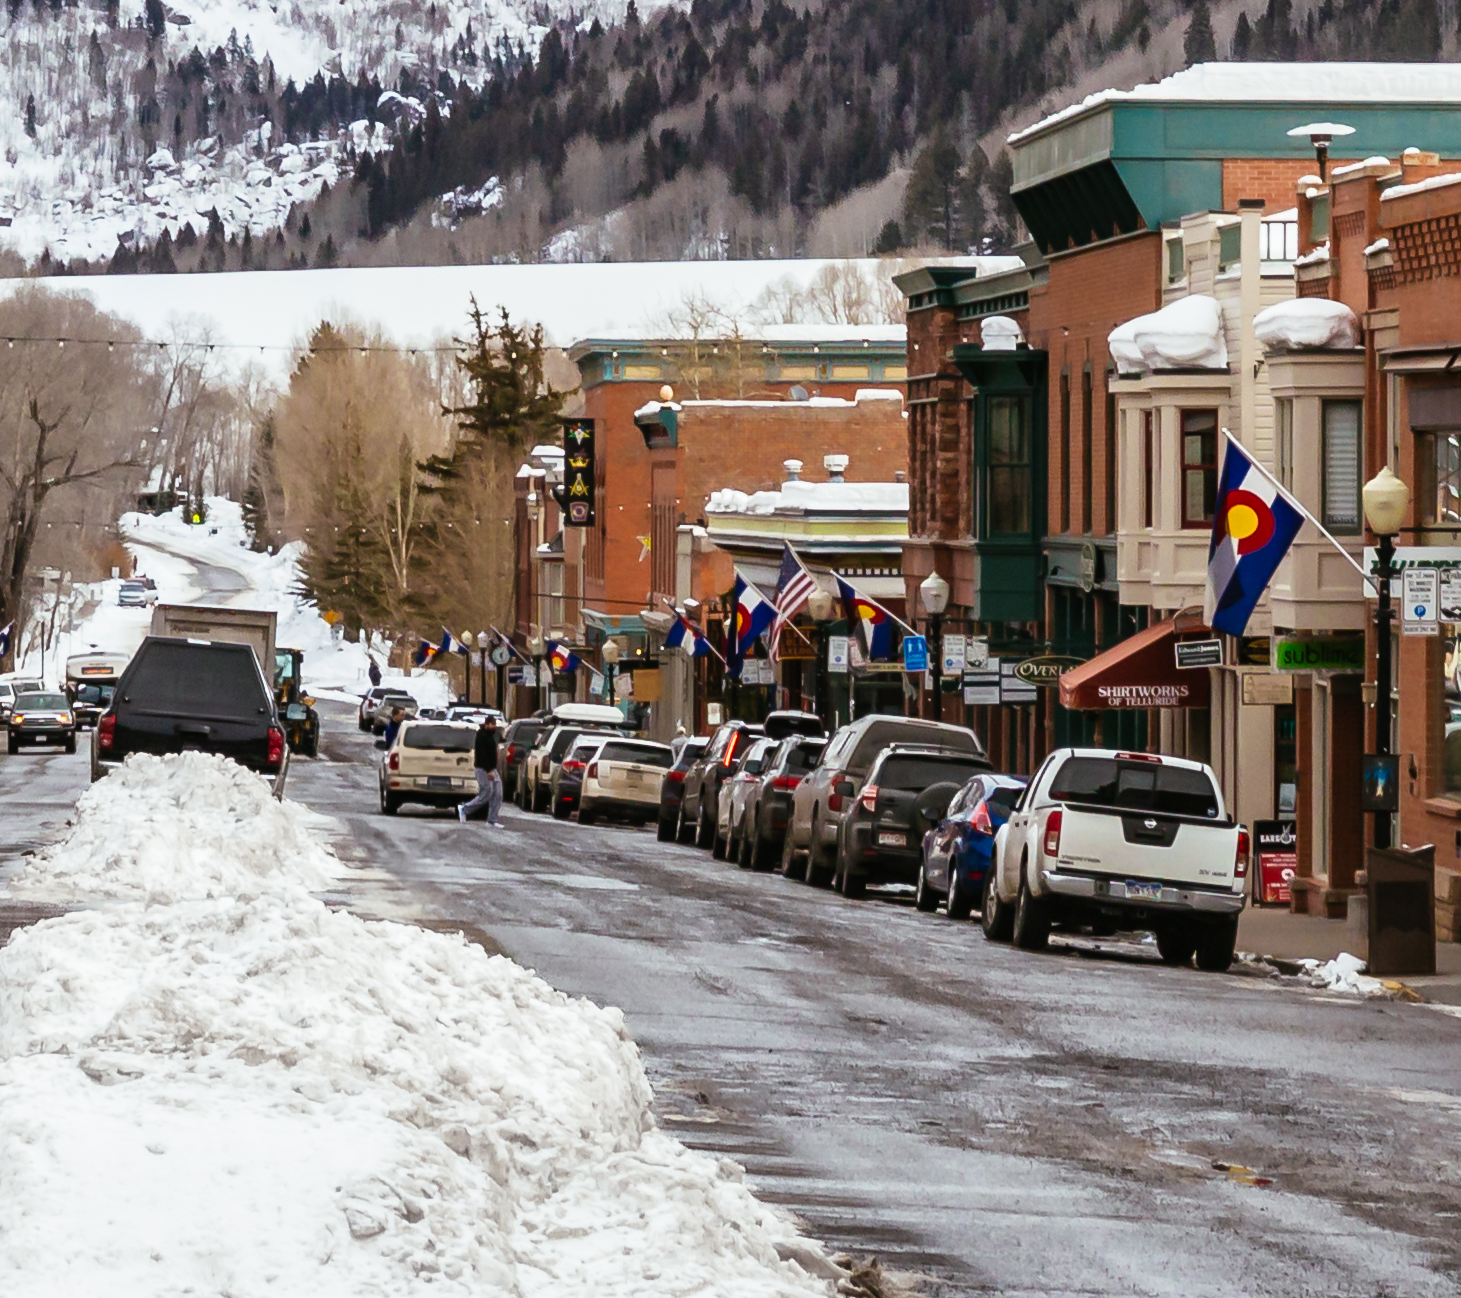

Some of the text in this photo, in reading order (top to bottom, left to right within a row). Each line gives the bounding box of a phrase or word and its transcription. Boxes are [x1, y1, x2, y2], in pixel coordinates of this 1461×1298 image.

[1283, 643, 1359, 665] sublime
[1098, 684, 1189, 698] SHIRTWORKS
[1108, 696, 1180, 706] OF TELLURIDE
